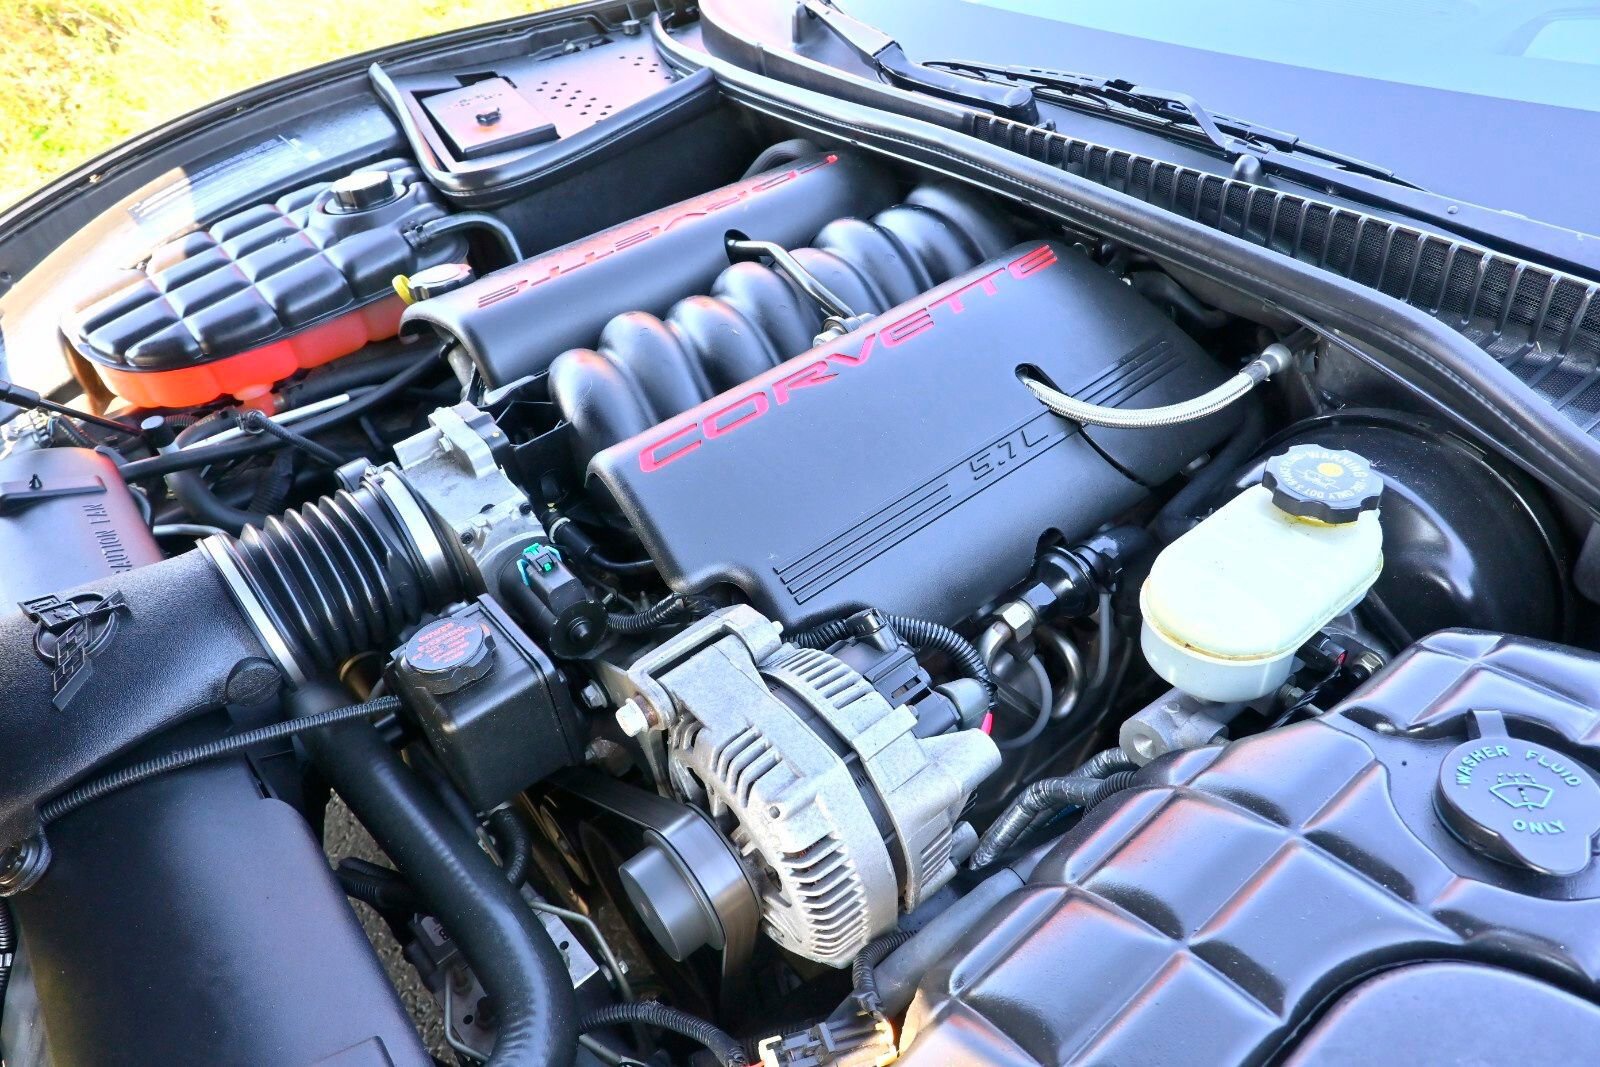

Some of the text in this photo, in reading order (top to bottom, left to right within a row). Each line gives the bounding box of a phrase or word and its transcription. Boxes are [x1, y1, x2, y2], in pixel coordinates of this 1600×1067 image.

[478, 154, 838, 308] CORVETTE
[638, 244, 1058, 473] CORVETTE
[970, 430, 1049, 480] 5.7L
[1456, 745, 1582, 787] WASHER FLUID
[1512, 819, 1566, 835] ONLY
